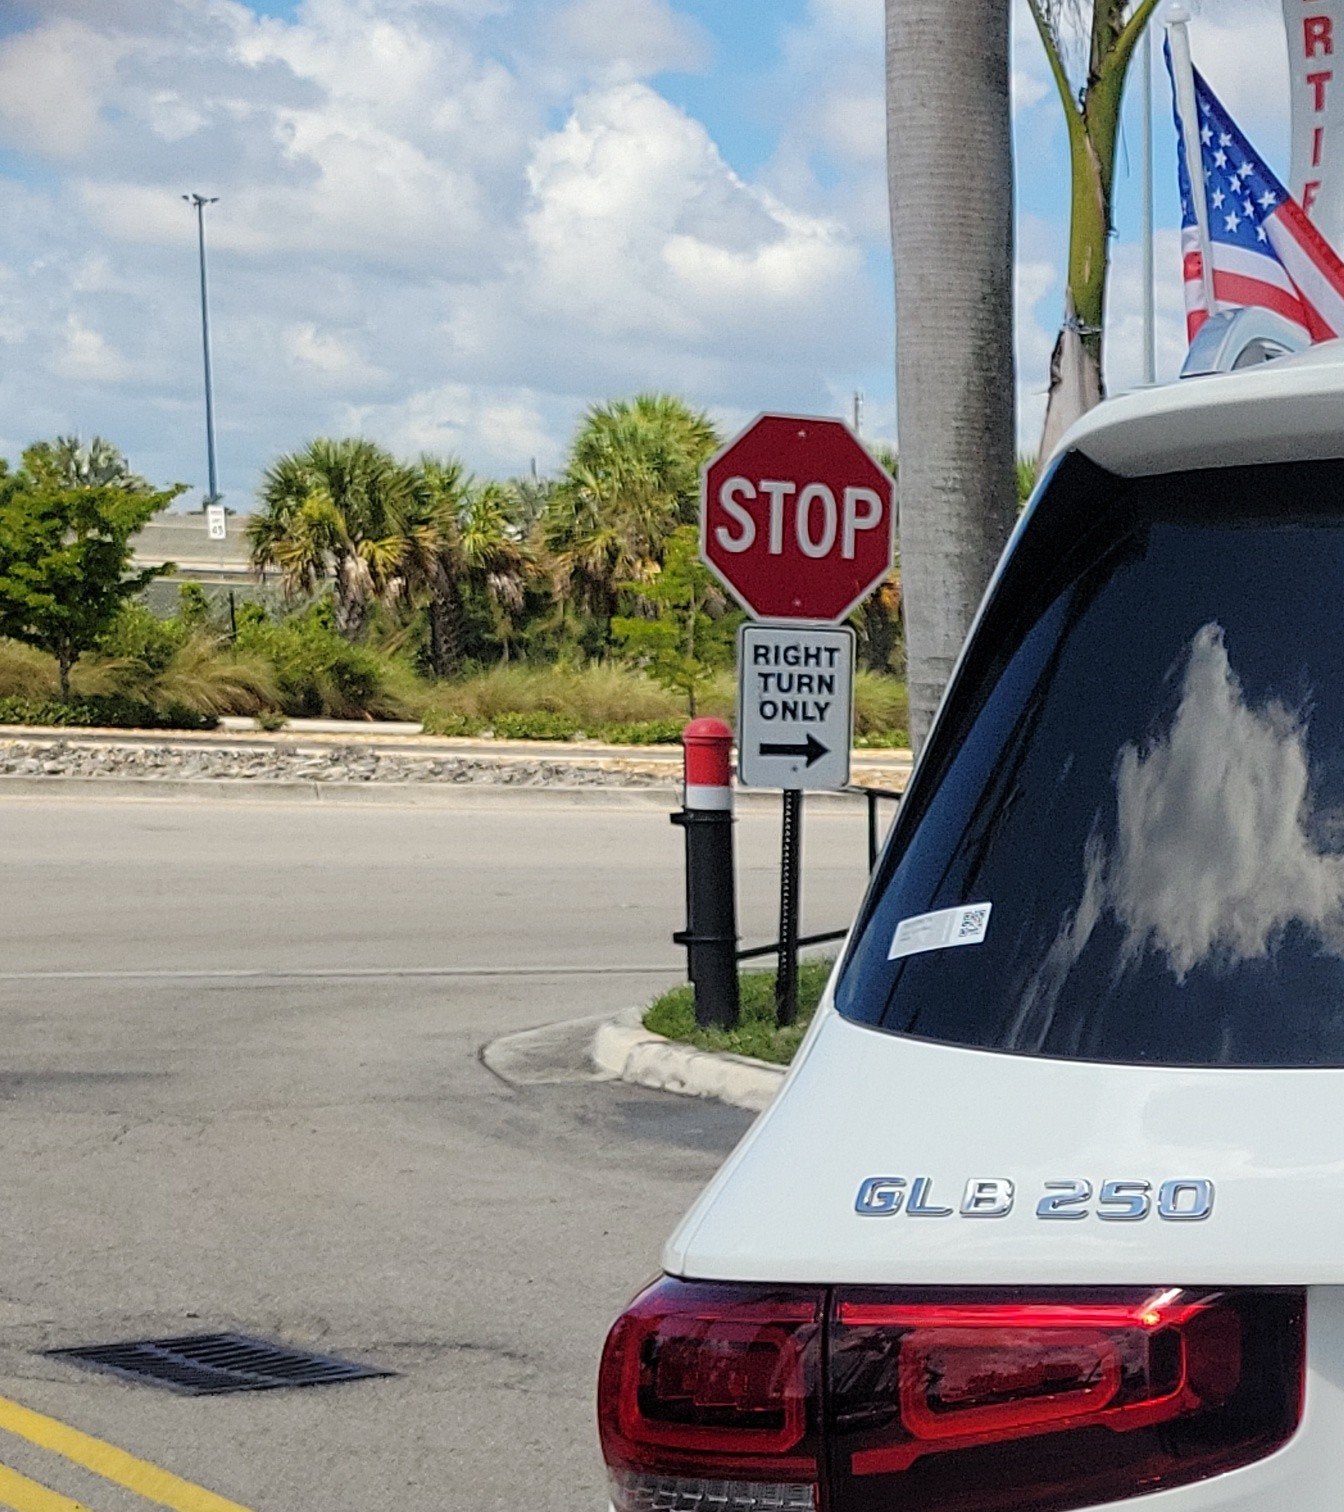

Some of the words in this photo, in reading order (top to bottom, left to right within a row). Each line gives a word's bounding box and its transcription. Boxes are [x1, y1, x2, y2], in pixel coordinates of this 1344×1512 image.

[715, 476, 882, 559] STOP
[754, 645, 840, 667] RIGHT
[758, 673, 834, 695] TURN
[760, 701, 830, 722] ONLY
[854, 1177, 1015, 1217] GLB
[1036, 1177, 1214, 1220] 250
